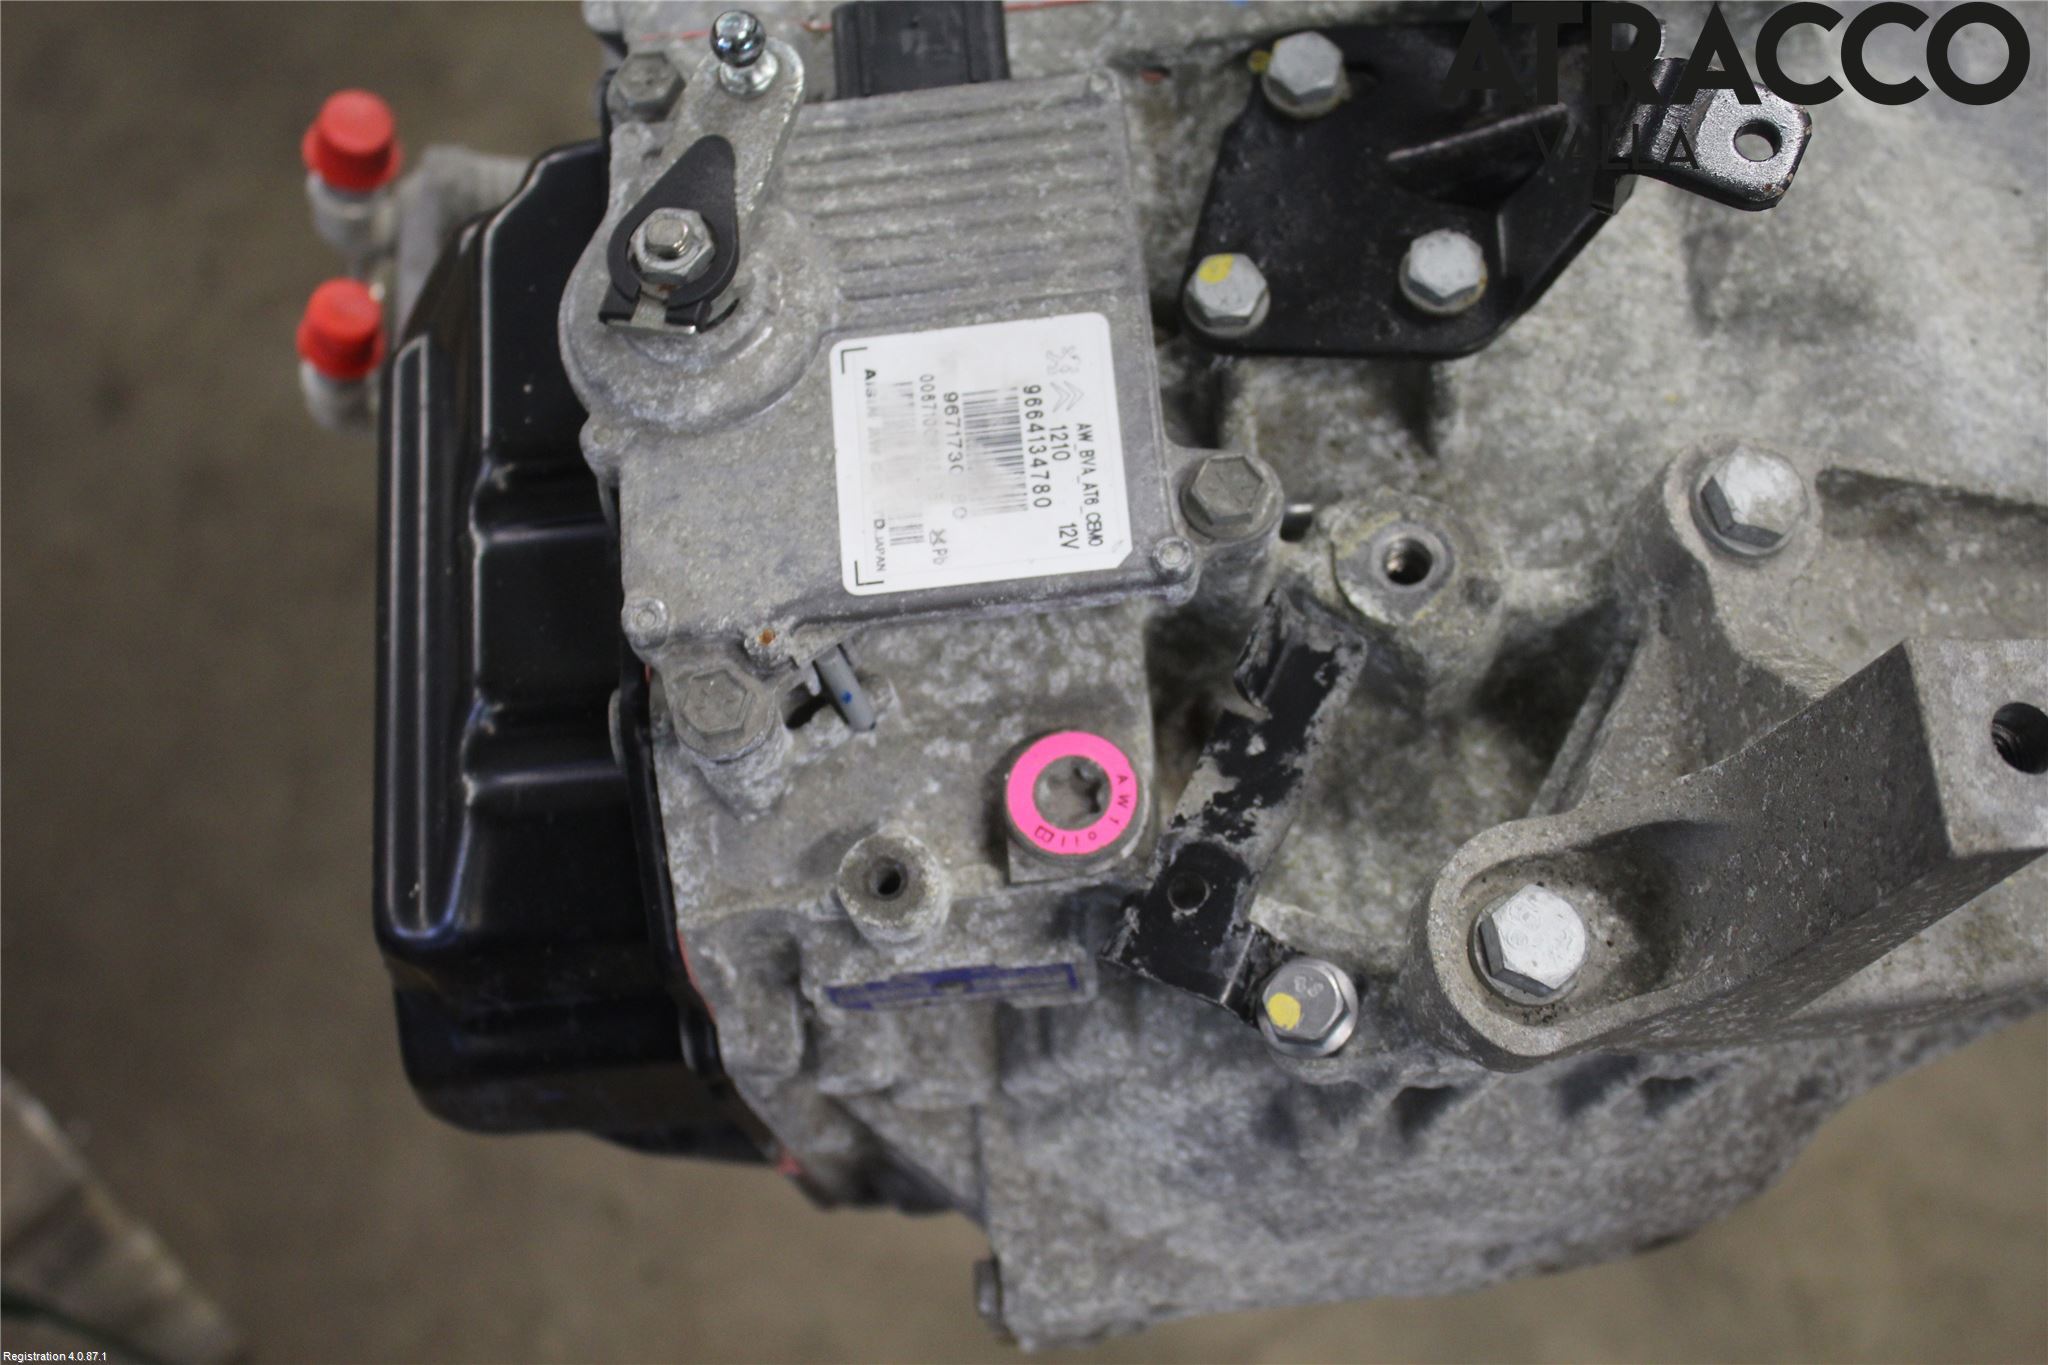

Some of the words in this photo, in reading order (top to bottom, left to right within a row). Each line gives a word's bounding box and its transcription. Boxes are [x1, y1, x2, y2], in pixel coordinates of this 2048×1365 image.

[1023, 384, 1053, 508] 9664134780
[1049, 424, 1071, 461] 1210
[1058, 522, 1080, 550] 12V
